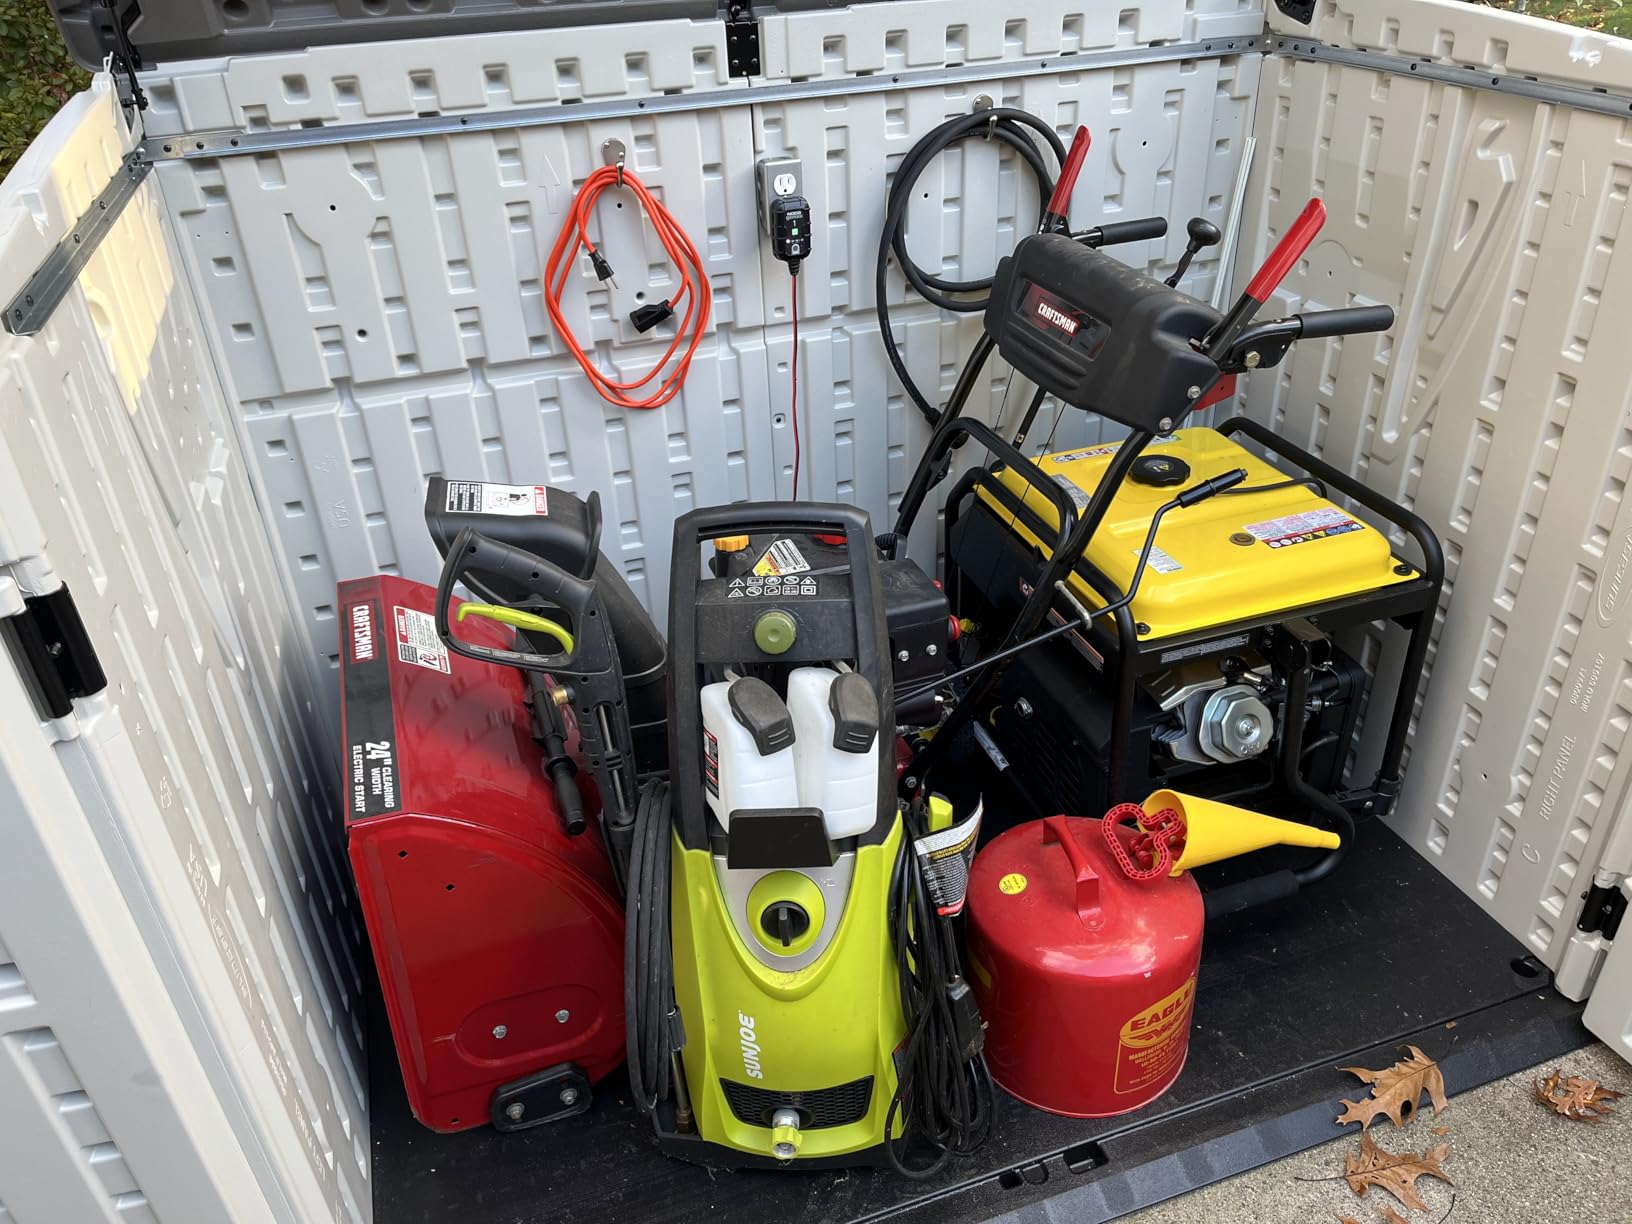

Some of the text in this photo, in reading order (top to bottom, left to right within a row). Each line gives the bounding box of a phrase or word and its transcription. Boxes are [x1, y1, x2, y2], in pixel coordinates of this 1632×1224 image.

[1037, 302, 1077, 334] CRAFTSMAN
[353, 605, 373, 660] CRAFTSMAN
[1580, 687, 1594, 713] MOLD
[352, 745, 366, 812] ELECTRIC START
[365, 741, 395, 808] 24" CLEARING
[371, 767, 382, 795] WIDTH
[1539, 735, 1577, 821] RIGHT PANEL
[1522, 843, 1541, 864] C
